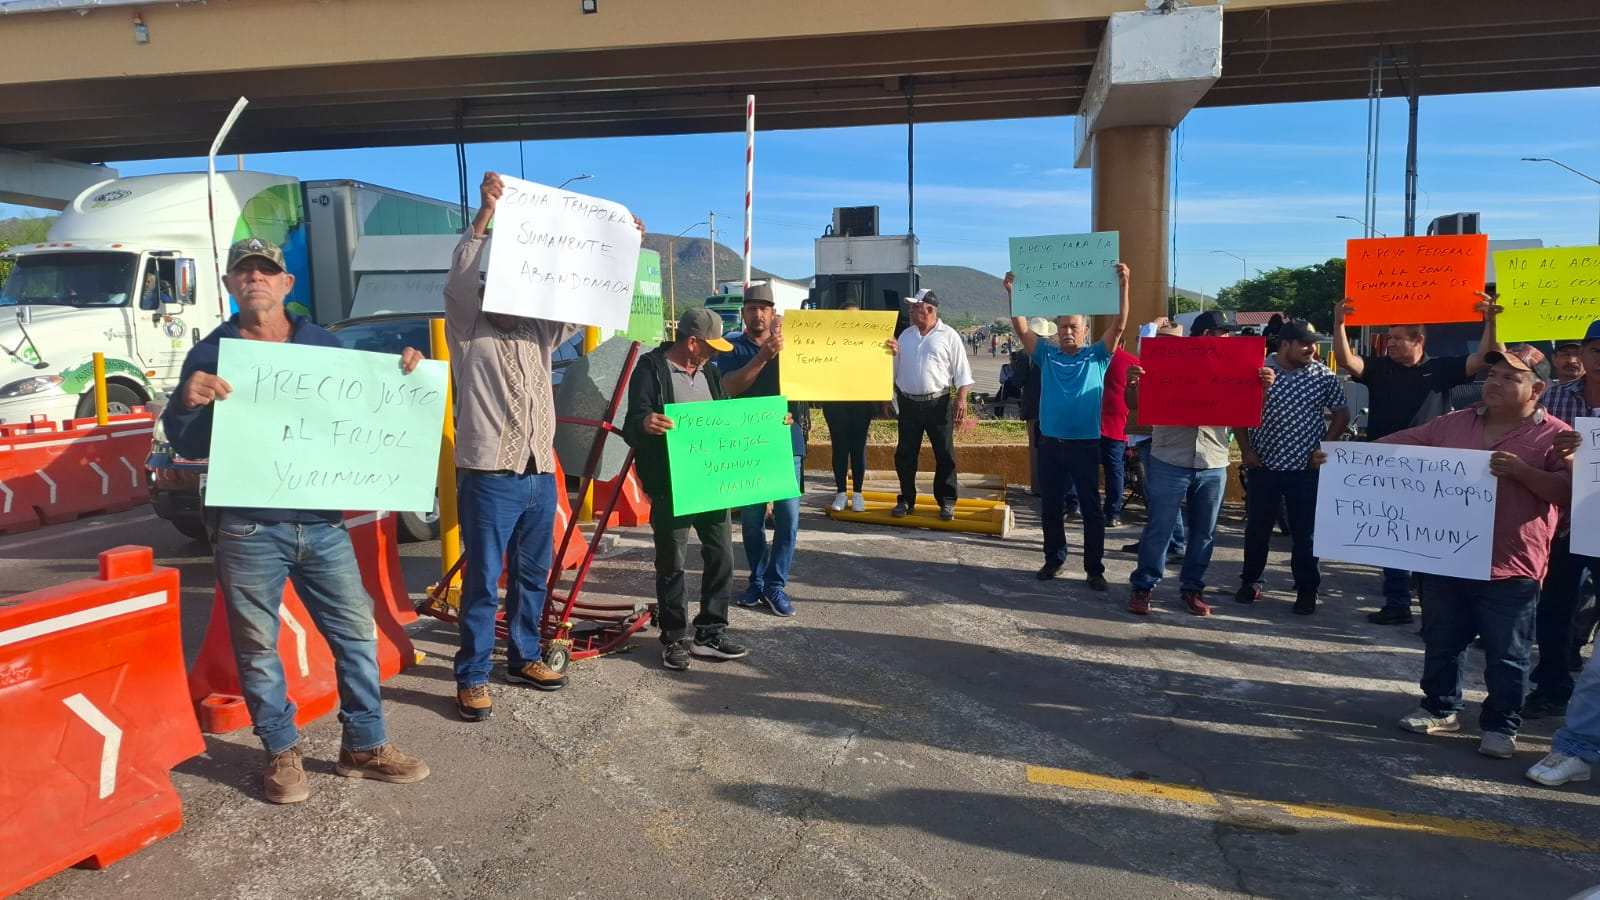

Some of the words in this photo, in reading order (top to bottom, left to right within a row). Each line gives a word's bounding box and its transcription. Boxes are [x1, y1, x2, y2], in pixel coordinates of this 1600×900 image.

[503, 187, 549, 206] ZONA
[517, 221, 616, 257] SUMAMENTE
[1063, 239, 1089, 250] PARA
[1416, 245, 1474, 257] FEDERAL
[1377, 268, 1384, 278] A
[1391, 267, 1408, 277] LA
[1418, 265, 1454, 275] ZONA
[1509, 257, 1528, 271] NO
[1539, 258, 1559, 270] AL
[520, 260, 631, 297] ABANDONADA
[1450, 278, 1468, 288] DE
[1537, 279, 1560, 289] LOS
[1512, 297, 1530, 309] EN
[1540, 297, 1561, 308] EL
[251, 364, 363, 404] PRECIO
[372, 381, 439, 414] JUSTO
[282, 418, 313, 442] AL
[331, 419, 413, 455] FRIJOL
[719, 434, 769, 452] FRIJOL
[1334, 447, 1467, 477] REAPERTURA
[269, 460, 401, 503] YURIMUNY
[1343, 473, 1426, 493] CENTRO
[1335, 498, 1410, 522] FRIJOL
[1353, 520, 1479, 554] YURIMUNY
